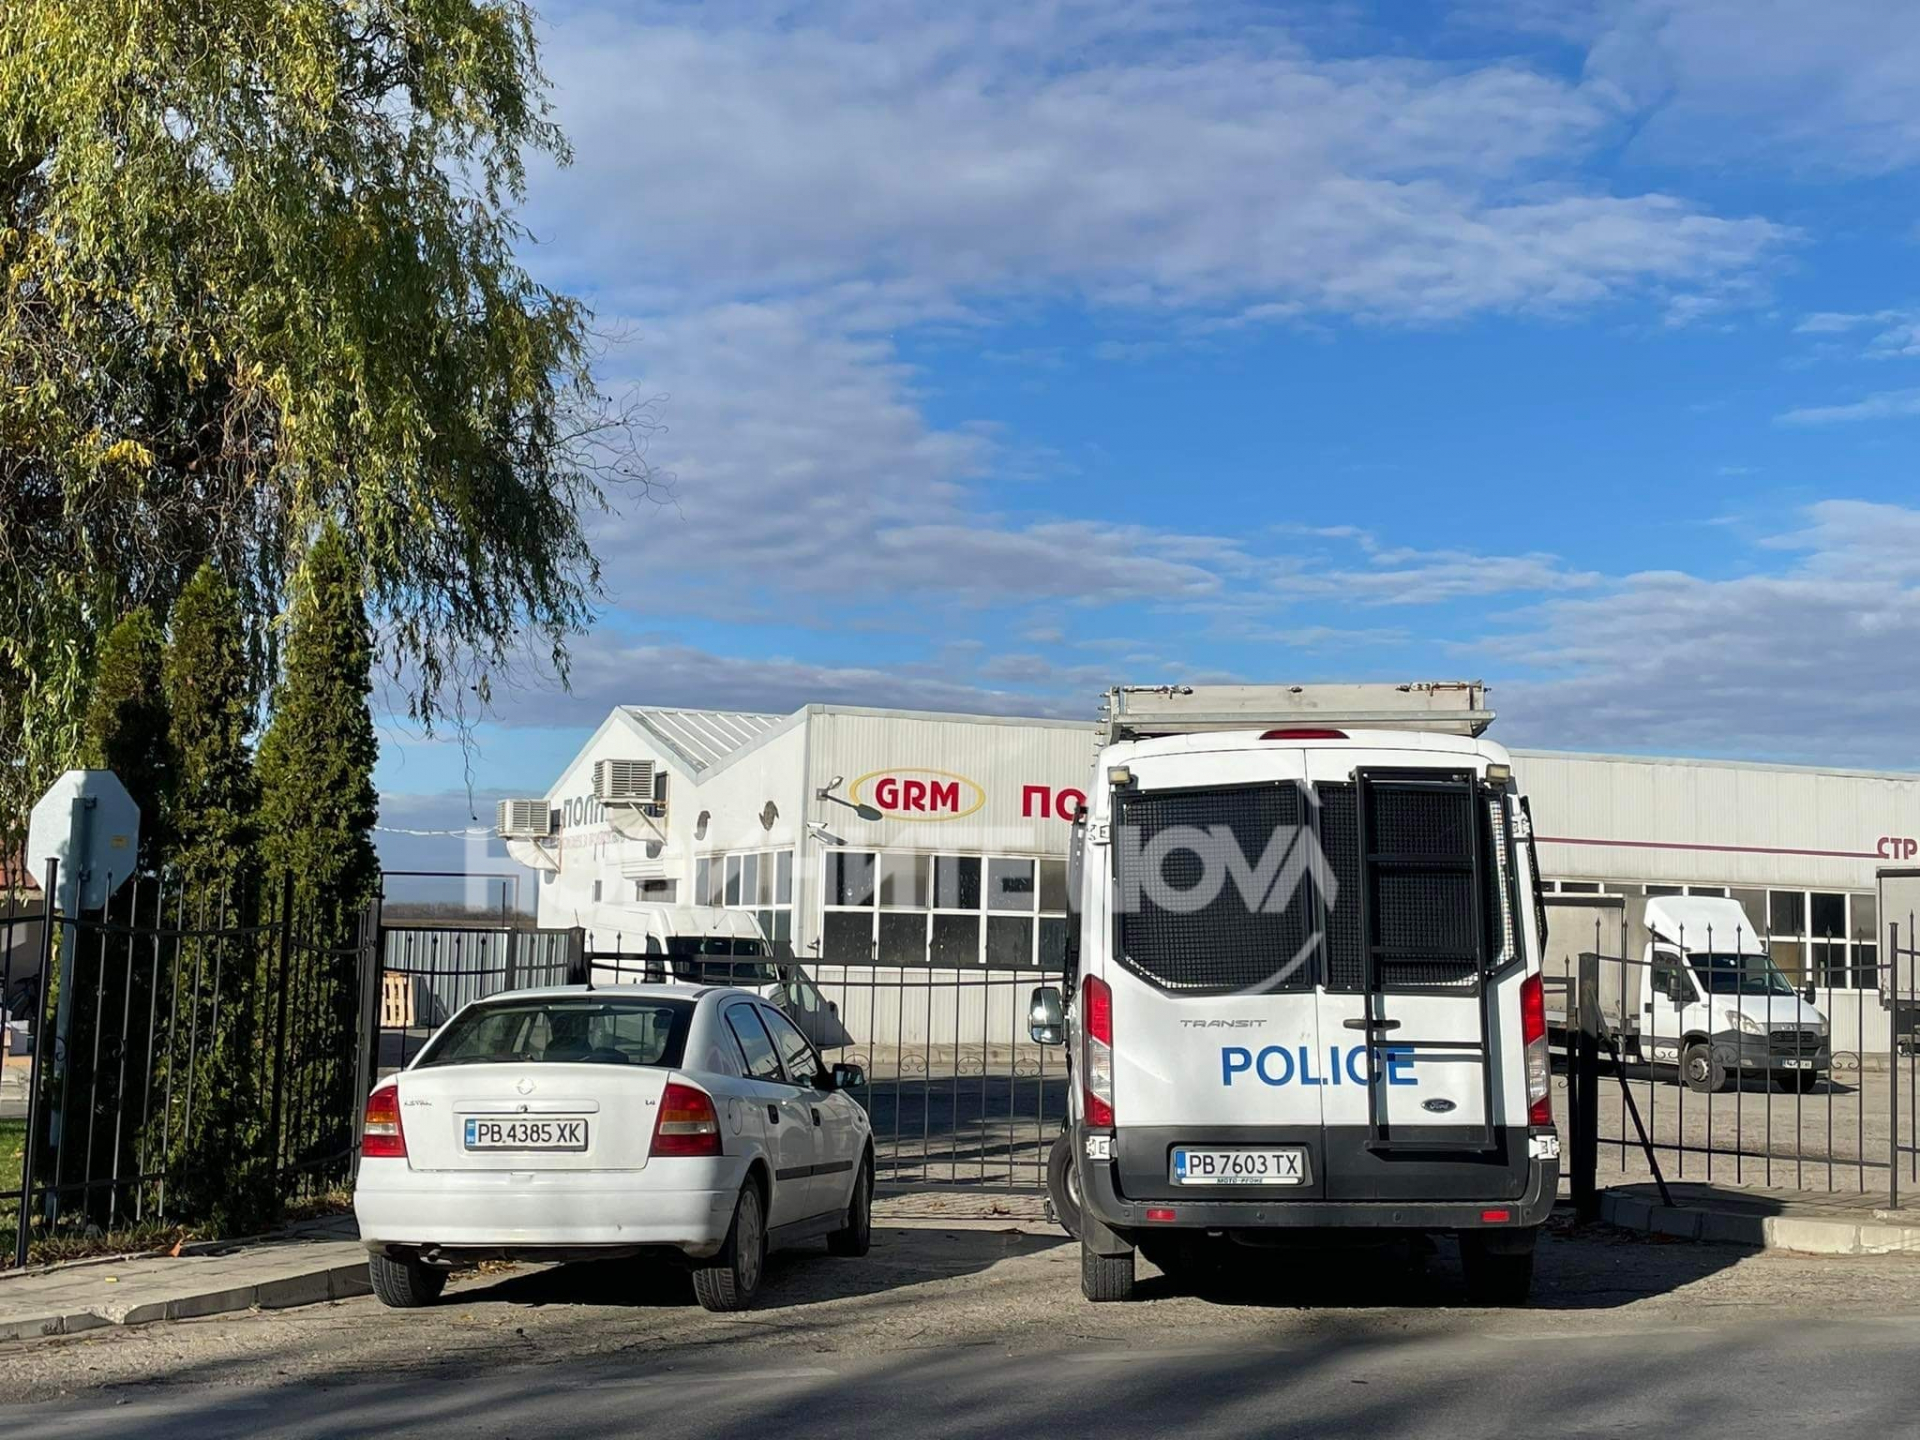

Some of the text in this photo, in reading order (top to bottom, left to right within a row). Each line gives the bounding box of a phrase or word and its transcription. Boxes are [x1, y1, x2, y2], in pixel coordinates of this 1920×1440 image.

[875, 777, 960, 812] GRM
[1180, 1019, 1267, 1028] TRANSIT
[1221, 1045, 1419, 1087] POLICE
[1219, 1154, 1268, 1175] 7603
[1272, 1154, 1298, 1175] TX
